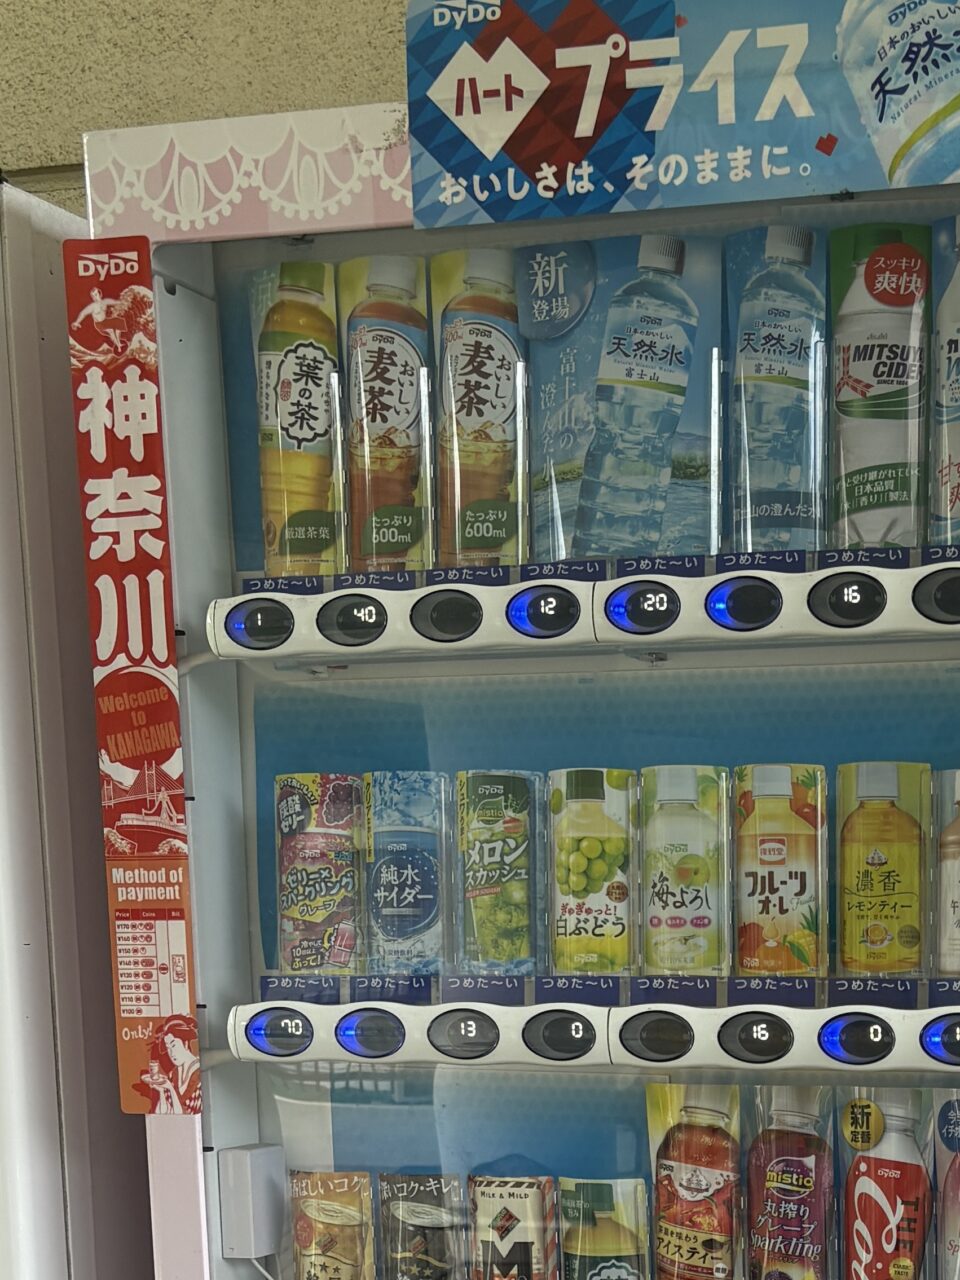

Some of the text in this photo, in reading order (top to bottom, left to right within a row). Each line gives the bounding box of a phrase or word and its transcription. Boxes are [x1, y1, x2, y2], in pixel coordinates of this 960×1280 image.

[433, 3, 501, 30] DyDo
[555, 23, 815, 138] プライス
[455, 73, 524, 116] ハート
[439, 145, 811, 206] おいしさは、そのままに。
[77, 252, 139, 281] DyDo
[529, 251, 569, 298] 新
[533, 297, 570, 322] 登場
[607, 336, 686, 365] 天然水
[740, 332, 810, 359] 天然水
[364, 346, 398, 424] 麦茶
[393, 360, 415, 416] おいしい
[625, 367, 659, 382] 富士山
[288, 355, 324, 431] 葉の茶
[76, 364, 169, 662] 神奈川
[465, 510, 507, 522] たっぷり
[465, 522, 506, 539] 600ml
[99, 686, 169, 714] Welcome
[106, 721, 180, 761] KANAGAWA
[467, 838, 529, 867] メロン
[112, 866, 184, 886] Method of
[380, 865, 418, 885] 純水
[466, 866, 529, 888] スカッシュ
[856, 869, 901, 893] 濃香
[117, 886, 181, 902] payment
[374, 885, 434, 908] サイダー
[649, 871, 712, 911] 梅よろし
[847, 901, 912, 911] レモンティー
[556, 916, 626, 938] 白ぶどう
[850, 1104, 871, 1130] 新
[763, 1199, 810, 1220] 丸搾り
[656, 1236, 724, 1265] アイスティー
[750, 1229, 822, 1262] Sparkling
